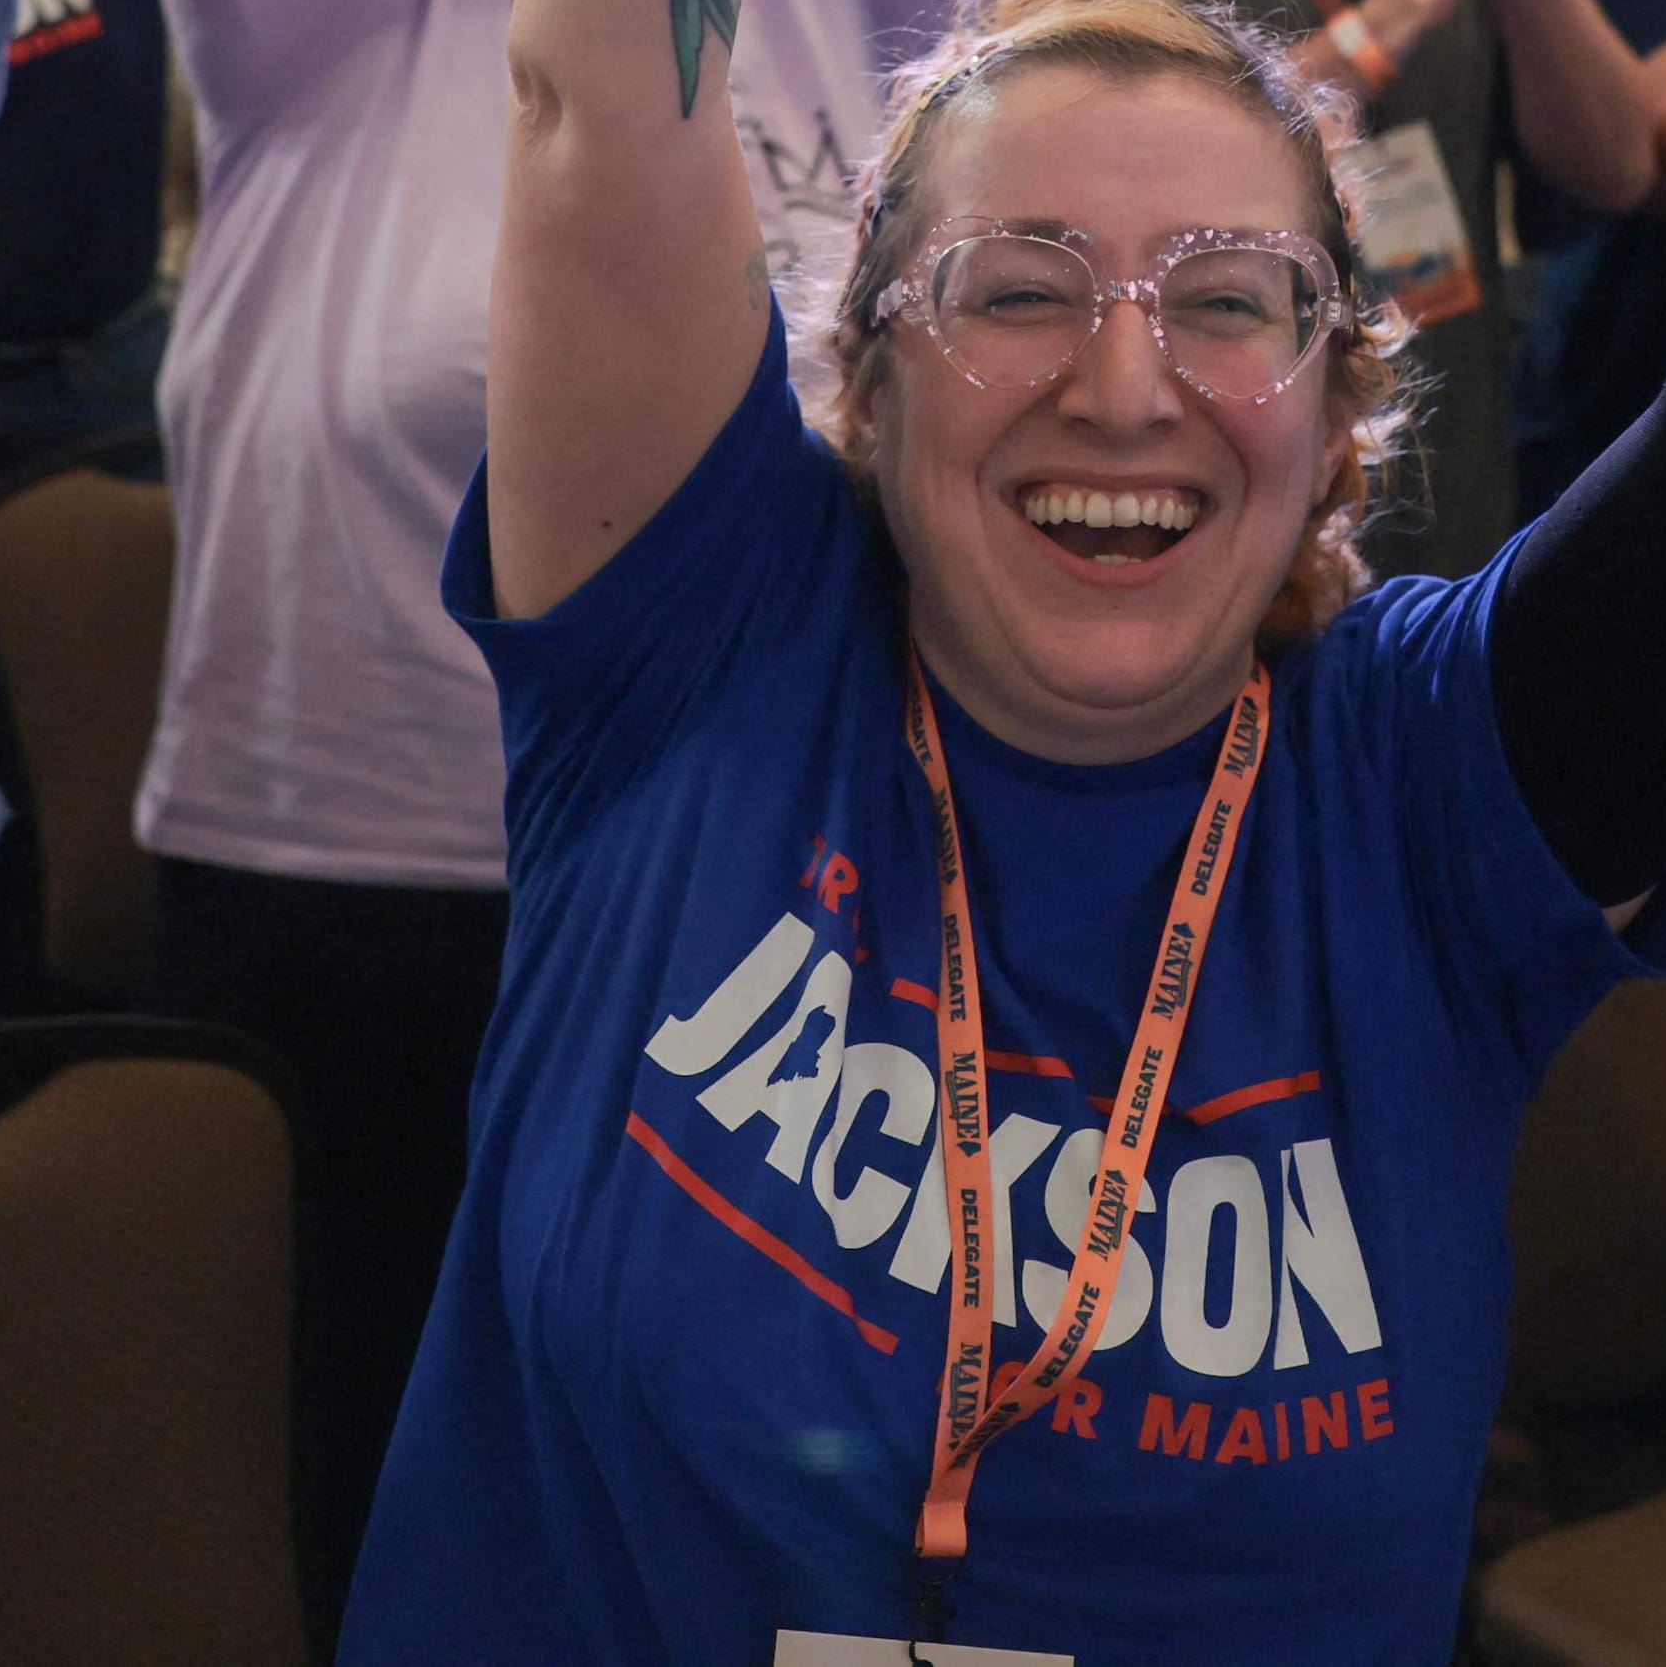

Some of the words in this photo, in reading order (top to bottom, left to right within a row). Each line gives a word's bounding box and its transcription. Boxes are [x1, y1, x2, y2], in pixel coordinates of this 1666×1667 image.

[943, 913, 967, 1022] DELEGATE
[952, 1050, 982, 1141] MAINE
[1035, 1280, 1102, 1390] DELEGATE
[1086, 1180, 1127, 1263] MAINE
[1120, 1044, 1164, 1150] DELEGATE
[1149, 931, 1193, 1023] MAINE
[1190, 799, 1233, 897] DELEGATE
[1223, 703, 1259, 780] MAINE
[643, 911, 1384, 1378] JACKSON
[960, 1188, 981, 1309] DELEGATE
[1137, 1377, 1394, 1466] MAINE
